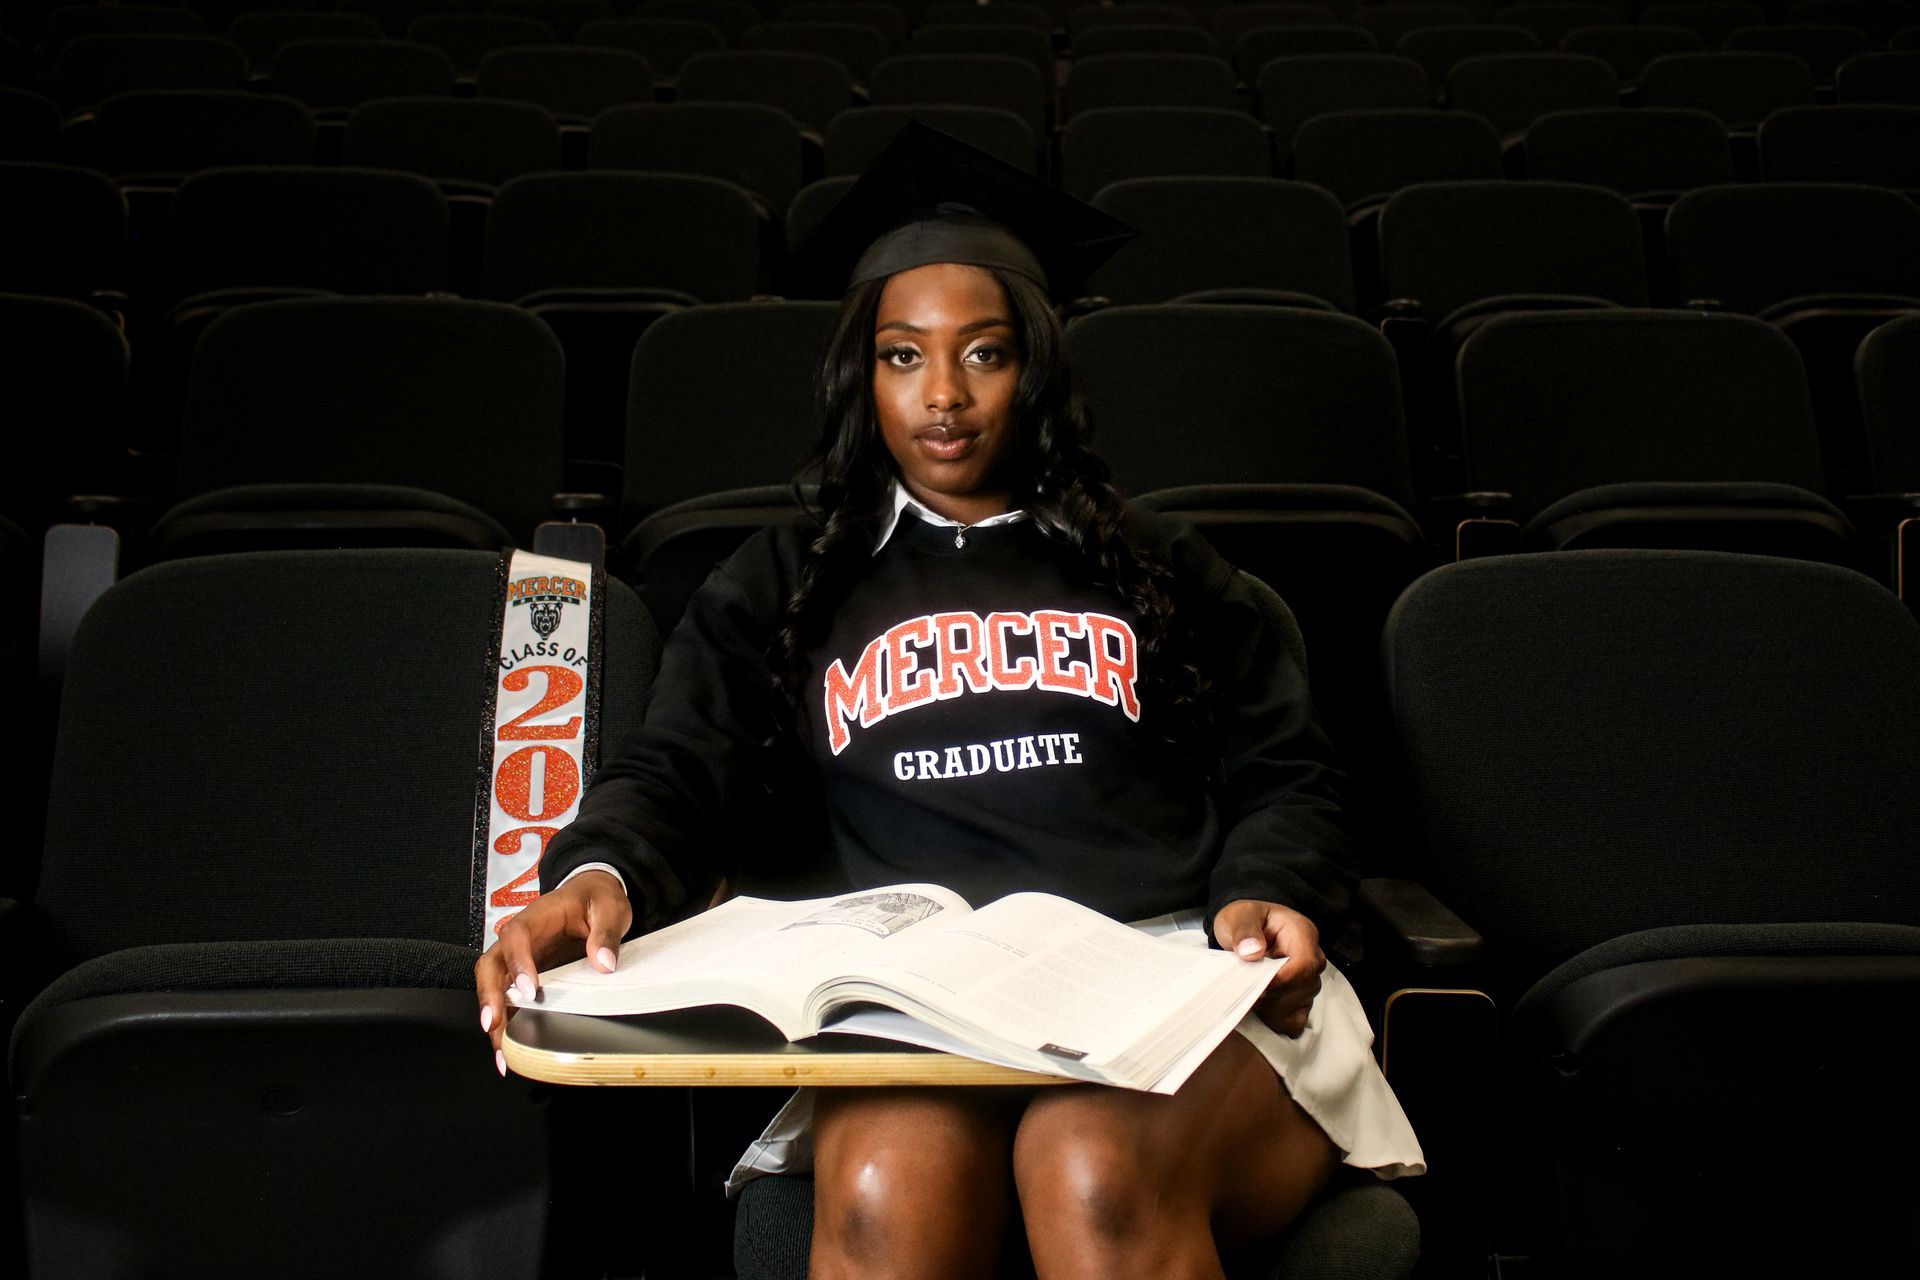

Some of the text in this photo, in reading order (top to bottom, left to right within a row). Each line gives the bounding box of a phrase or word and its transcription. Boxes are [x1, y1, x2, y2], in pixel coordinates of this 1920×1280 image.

[507, 576, 587, 601] MERCER
[499, 641, 590, 670] CLASS OF
[825, 609, 1141, 756] MERCER
[893, 733, 1083, 781] GRADUATE
[490, 665, 584, 938] 202
